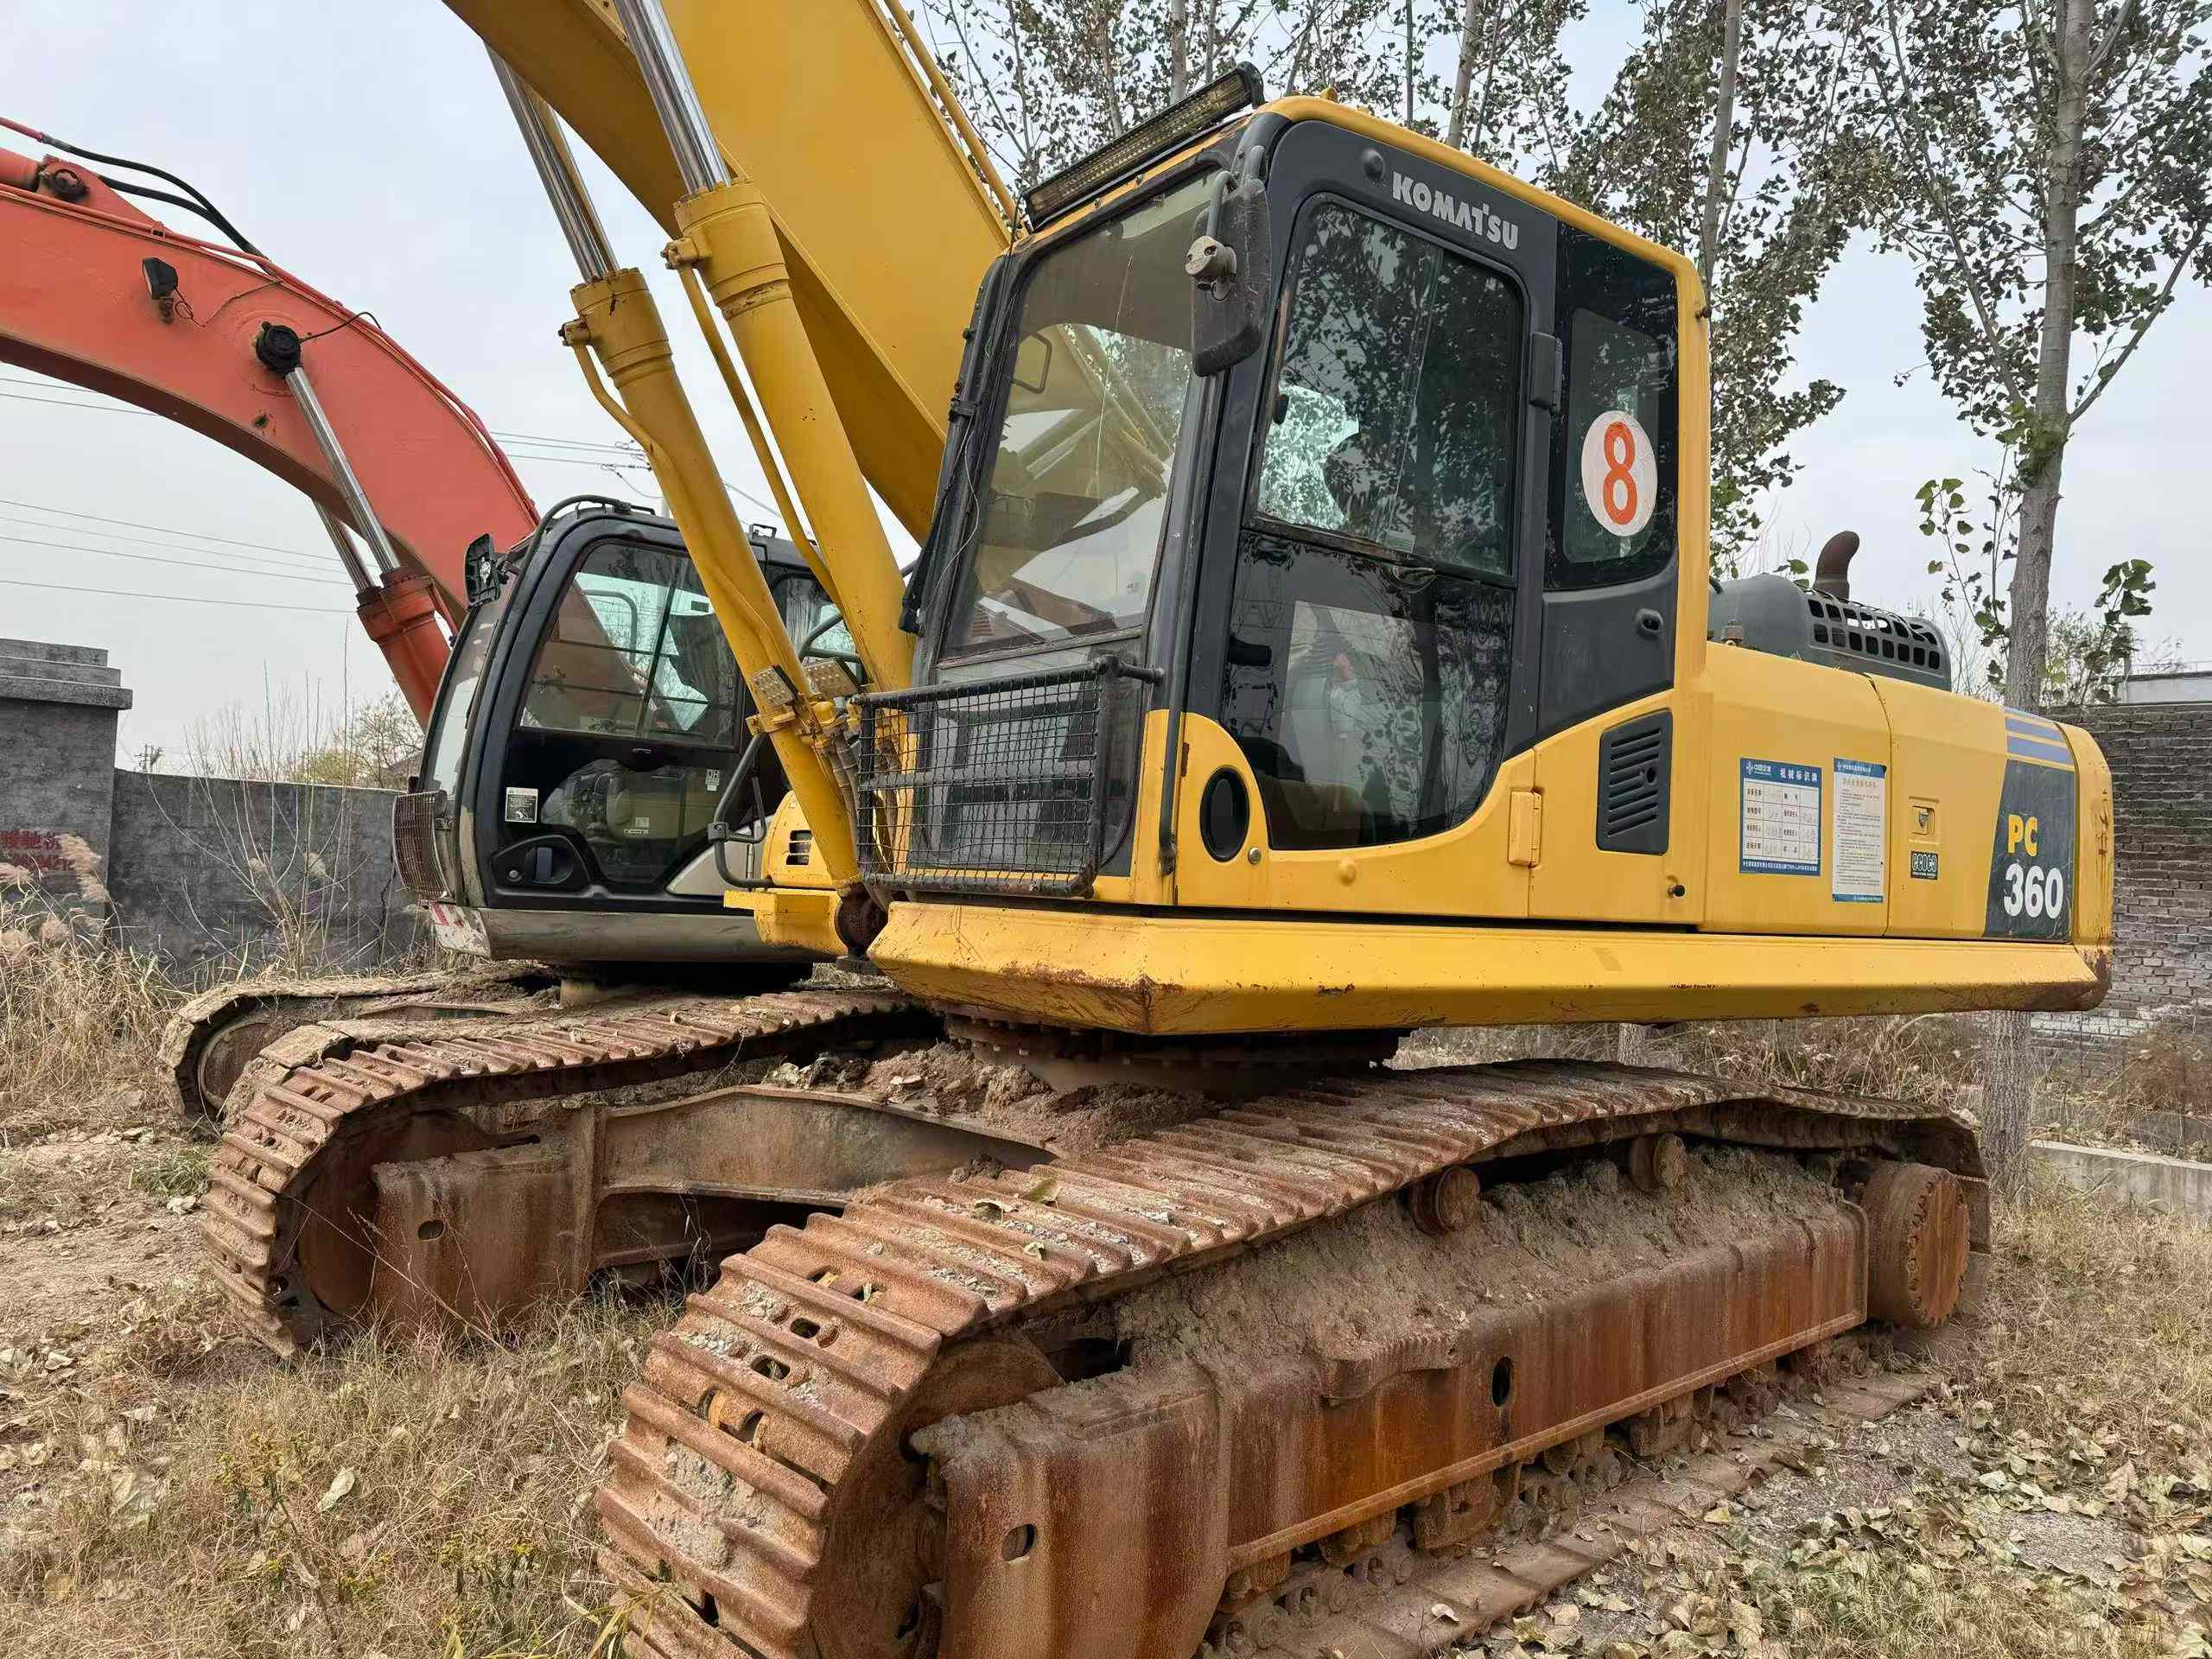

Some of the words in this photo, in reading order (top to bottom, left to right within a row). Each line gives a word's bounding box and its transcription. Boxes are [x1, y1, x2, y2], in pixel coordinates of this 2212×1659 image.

[1392, 171, 1519, 251] KOMATSU
[1603, 421, 1638, 525] 8
[2008, 814, 2038, 856] PC
[2004, 863, 2063, 918] 360
